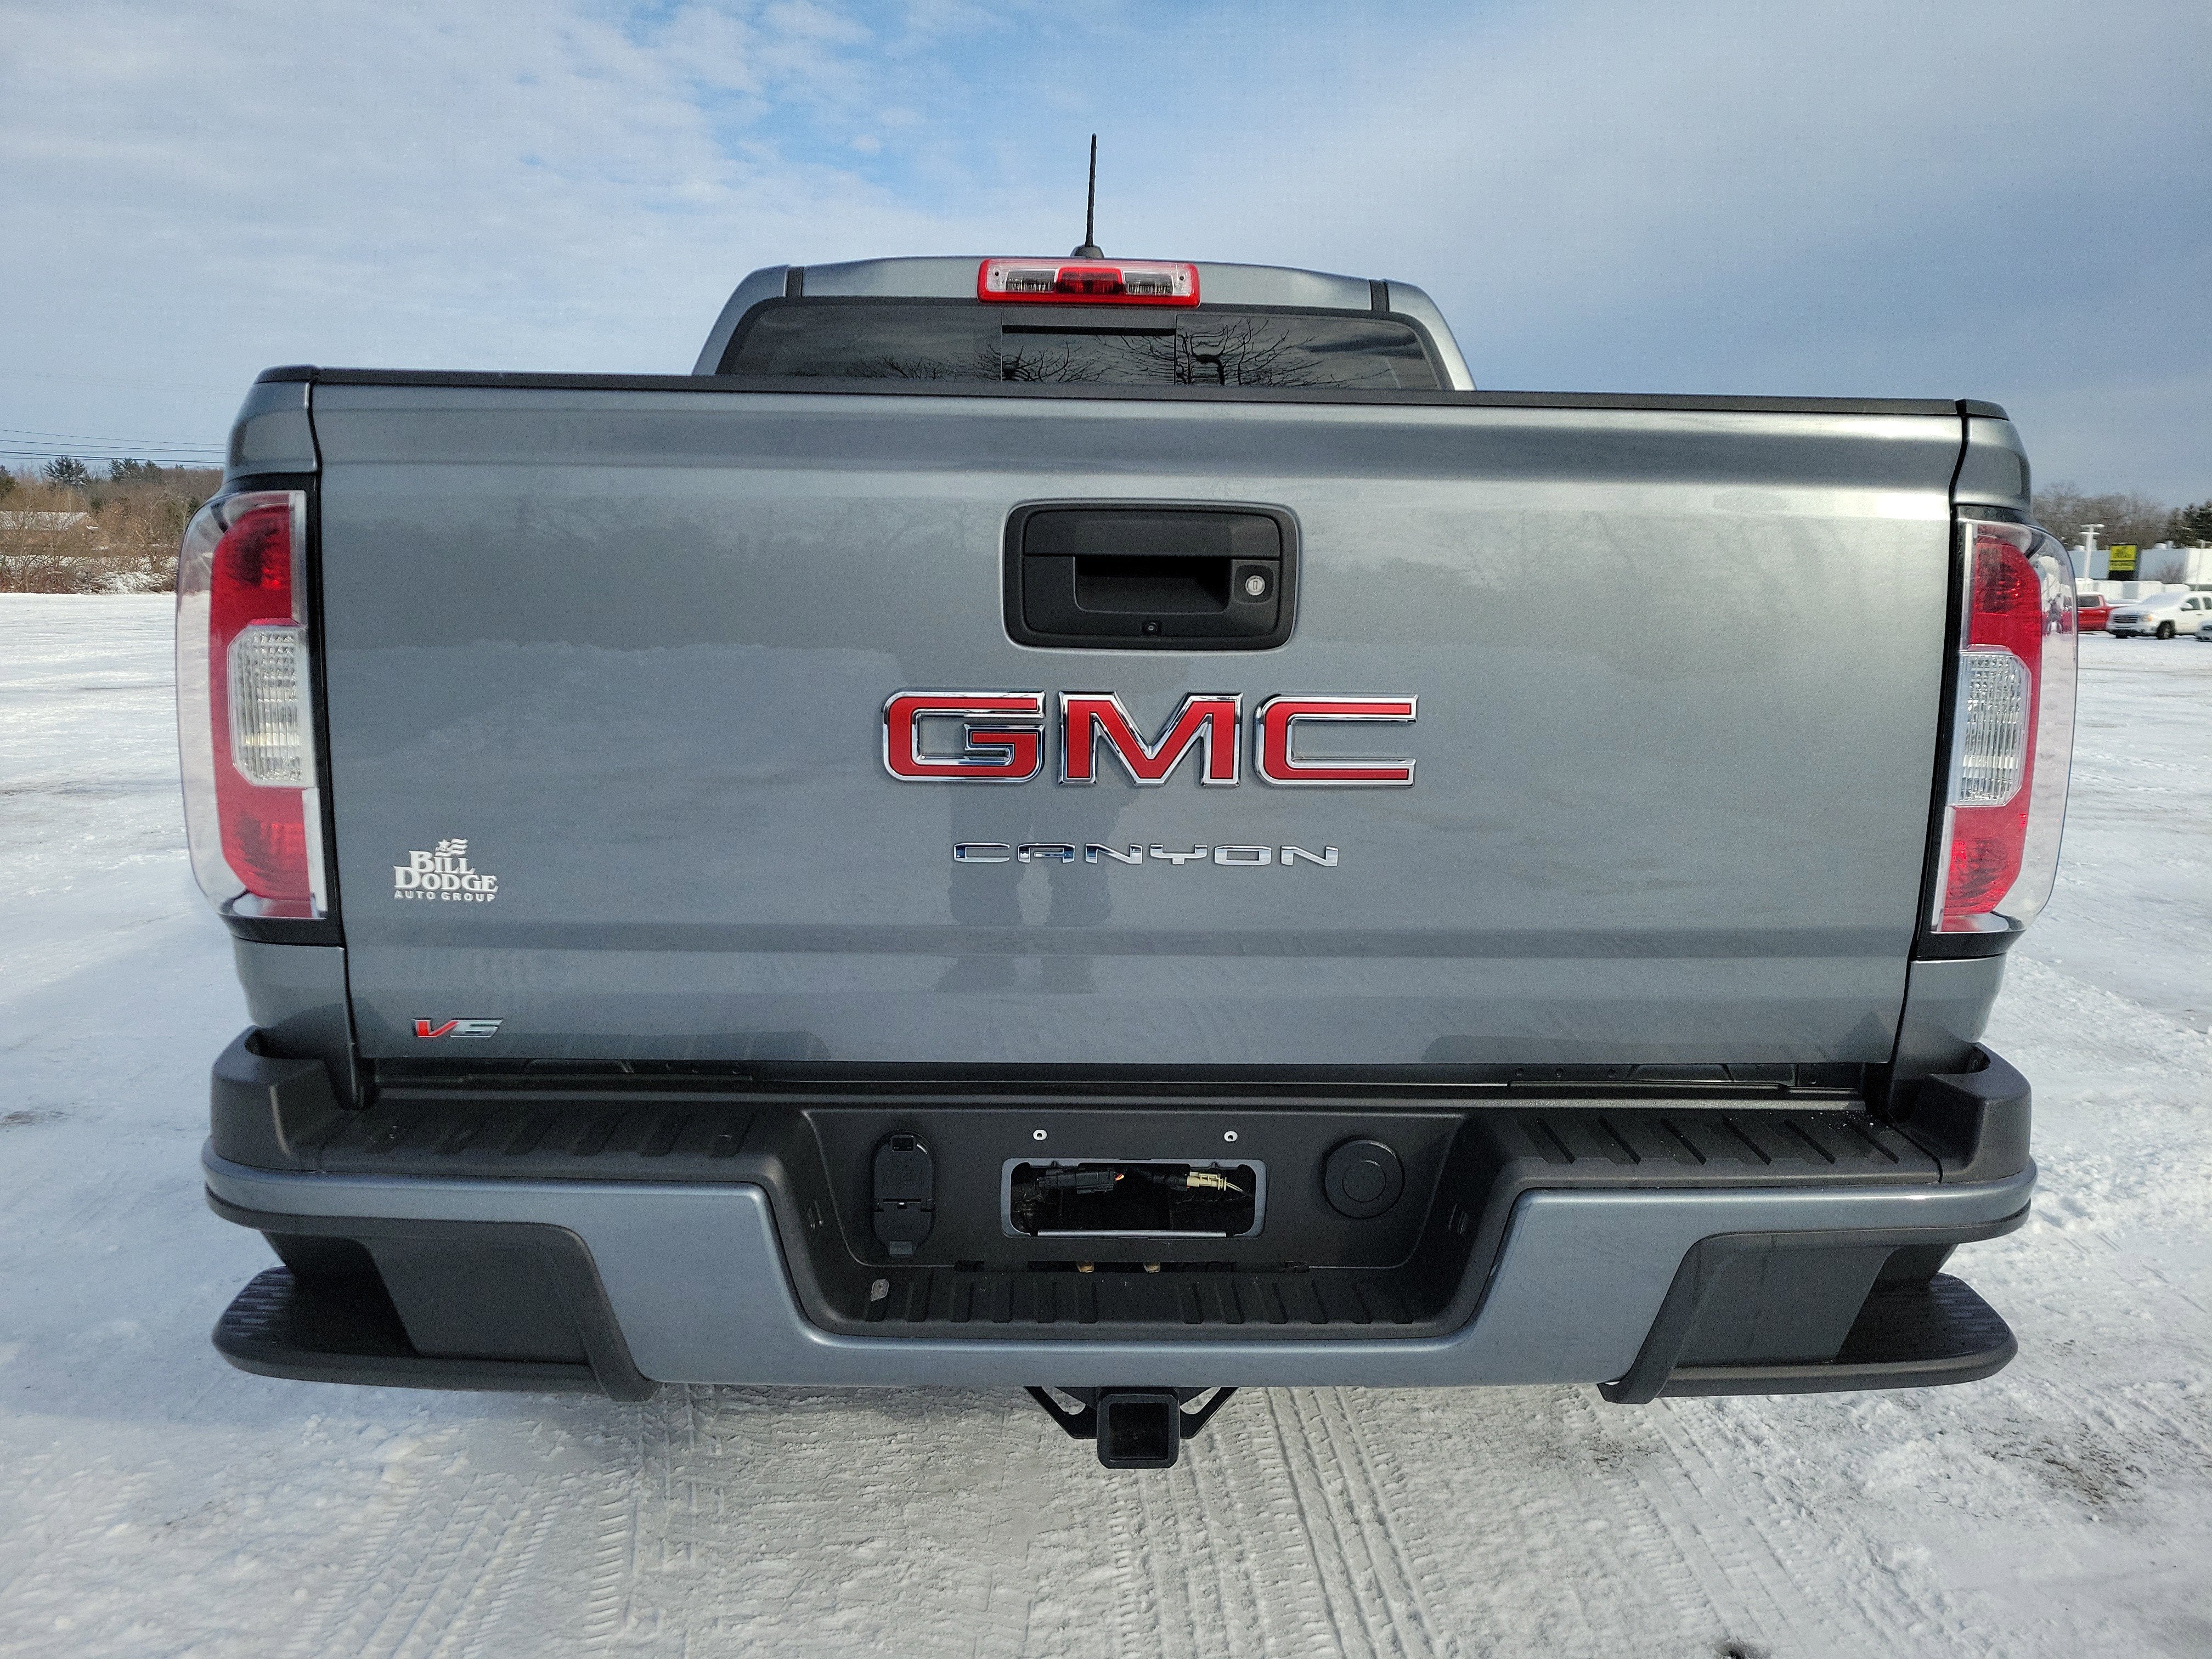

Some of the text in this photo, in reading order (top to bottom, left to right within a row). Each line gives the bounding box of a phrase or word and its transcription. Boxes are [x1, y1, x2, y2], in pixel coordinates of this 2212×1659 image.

[882, 690, 1419, 787] GMC
[408, 850, 476, 874] BILL
[953, 842, 1339, 867] CANYON
[393, 865, 499, 893] DODGE
[394, 890, 495, 902] AUTO GROUP
[413, 1018, 504, 1038] V6
